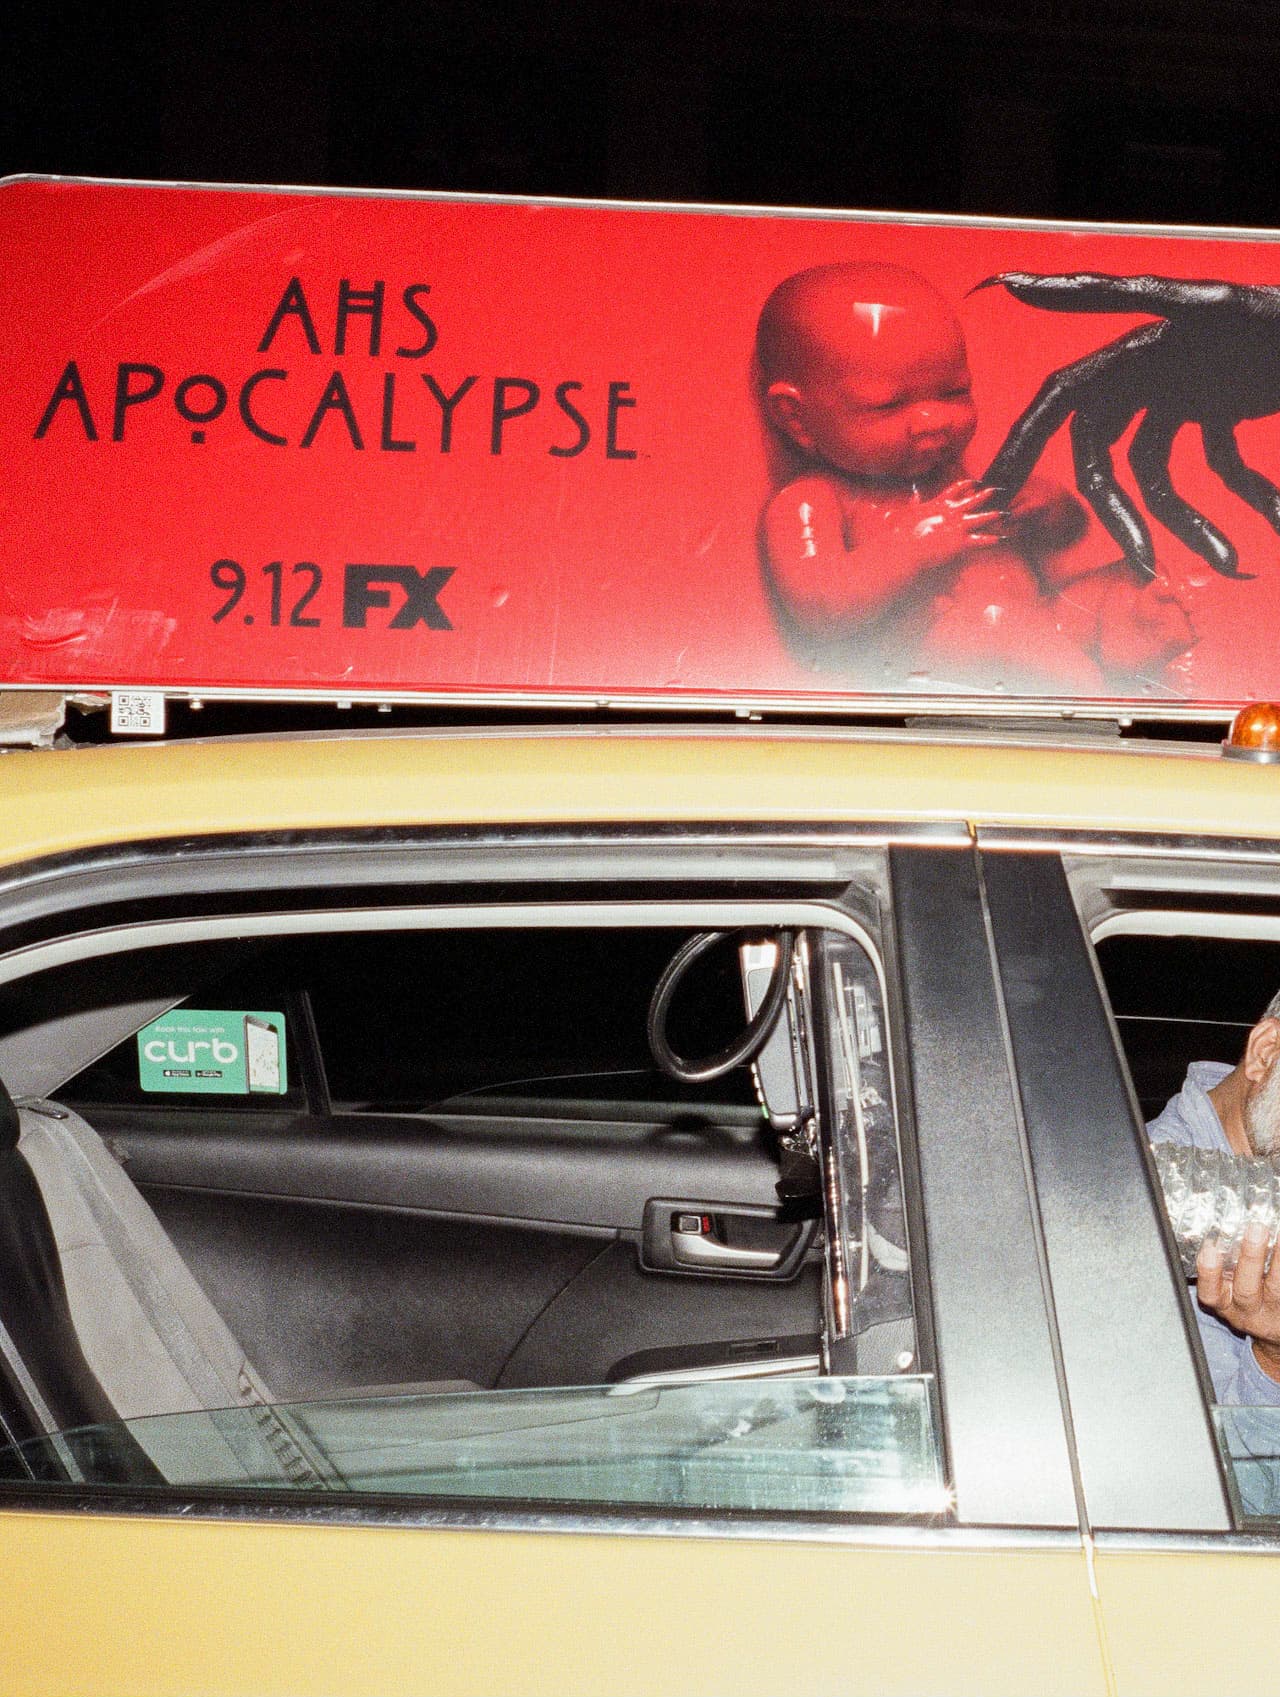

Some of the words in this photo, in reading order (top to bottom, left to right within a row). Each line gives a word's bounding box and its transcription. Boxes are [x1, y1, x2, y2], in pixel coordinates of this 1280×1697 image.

[258, 278, 437, 358] AHS
[34, 361, 636, 459] APOCALYPSE
[211, 560, 322, 626] 9.12
[343, 565, 454, 630] FX
[144, 1038, 238, 1063] curb
